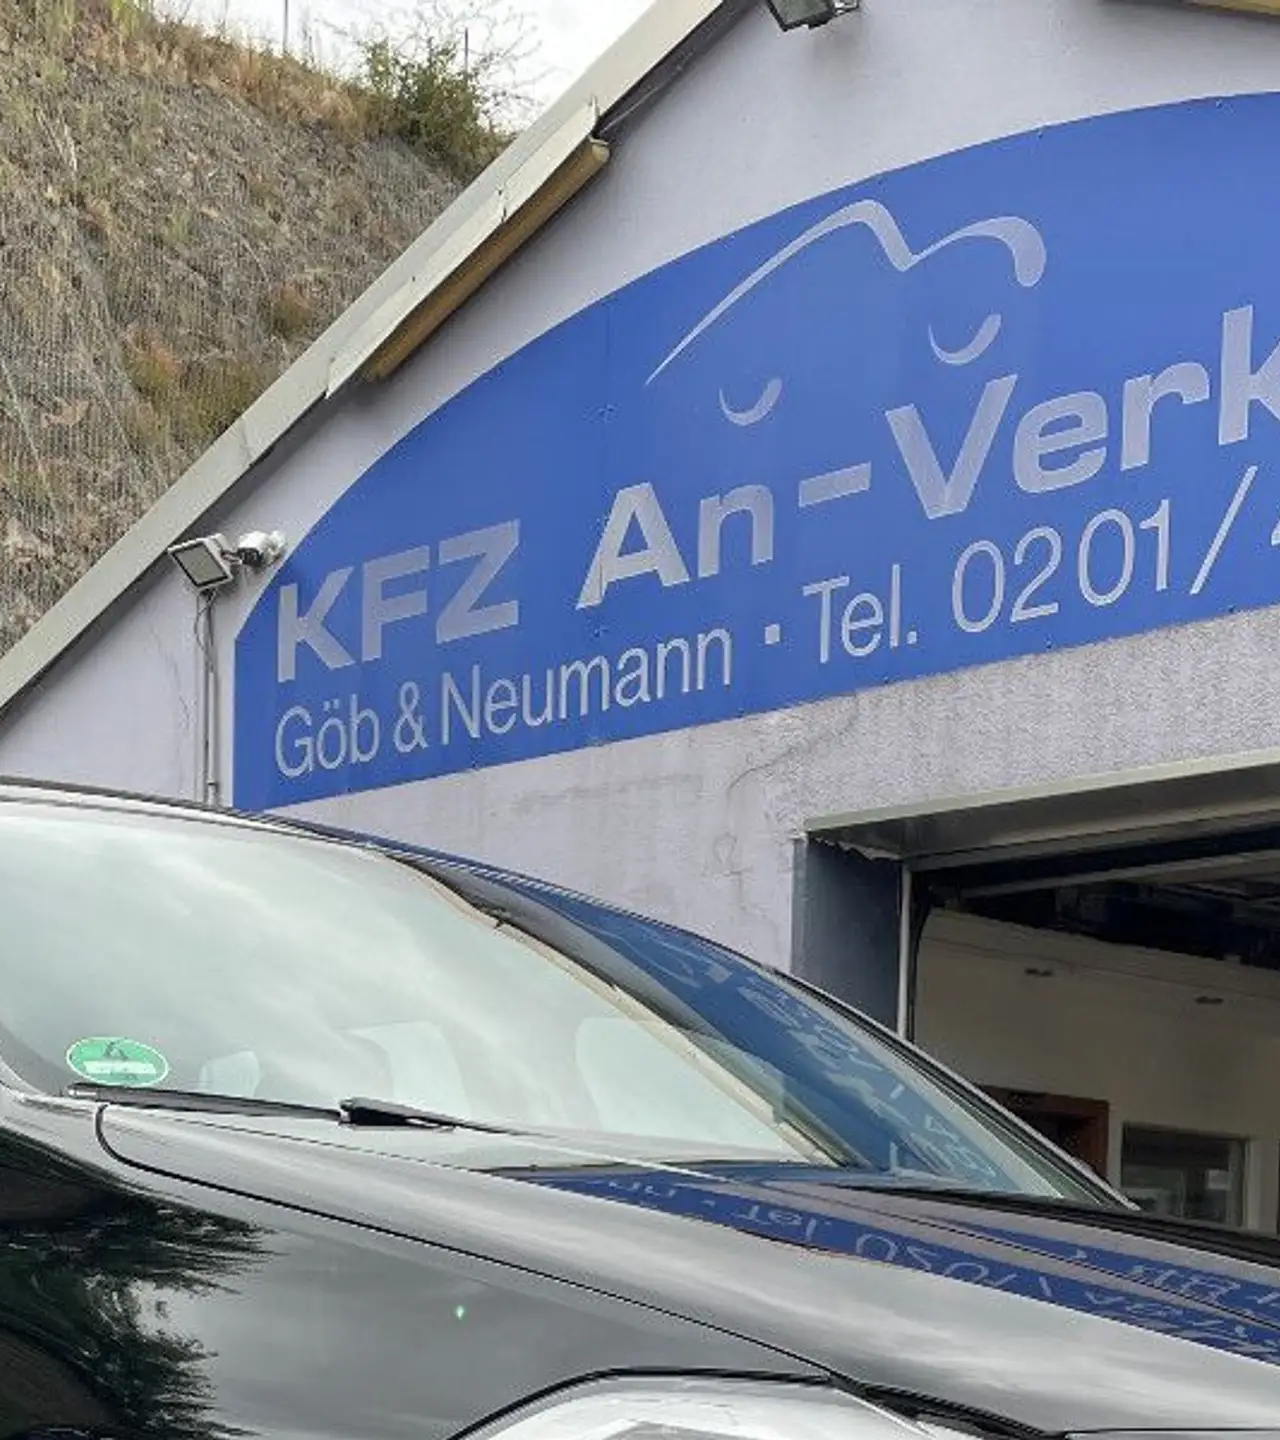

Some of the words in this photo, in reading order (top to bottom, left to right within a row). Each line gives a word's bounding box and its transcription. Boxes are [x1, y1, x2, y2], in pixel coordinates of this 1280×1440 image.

[275, 694, 381, 777] Göb
[393, 681, 428, 753] &
[441, 626, 732, 747] Neumann
[803, 563, 917, 664] Tel.
[277, 518, 521, 683] KFZ
